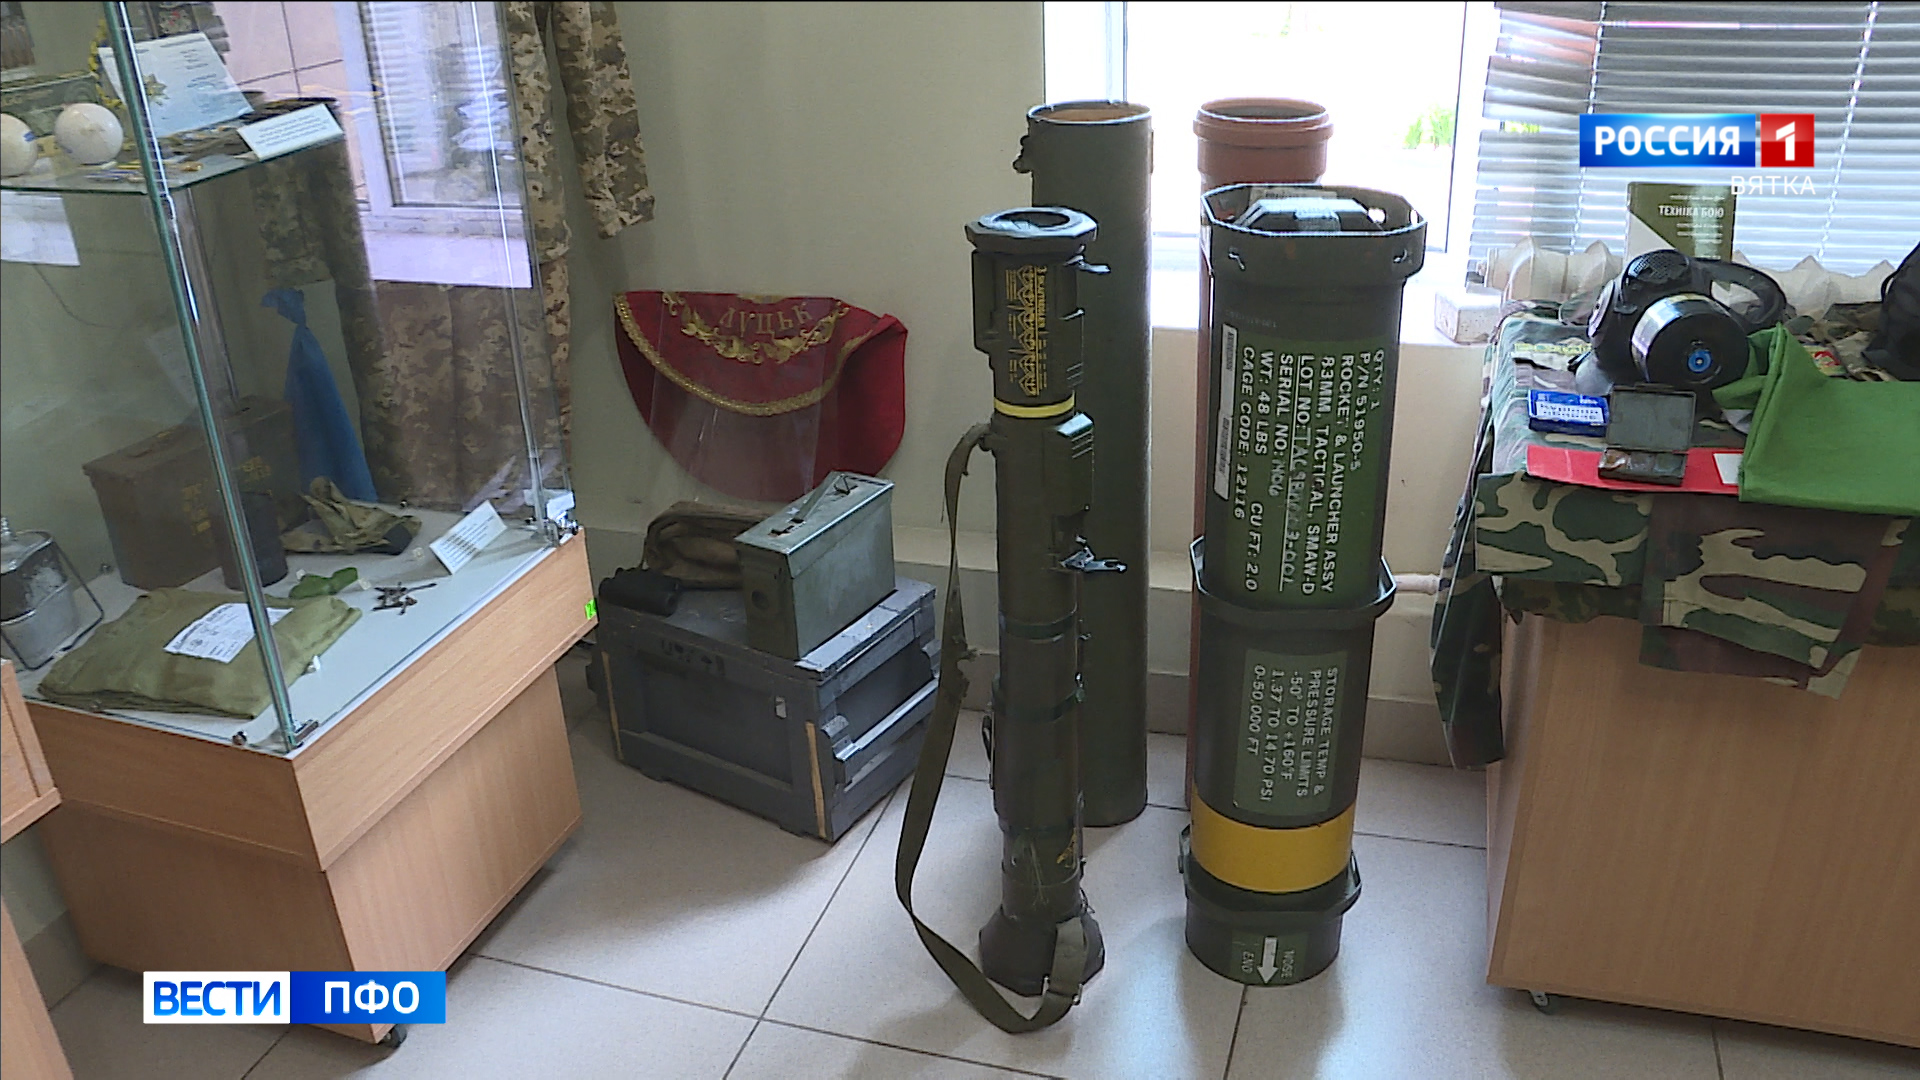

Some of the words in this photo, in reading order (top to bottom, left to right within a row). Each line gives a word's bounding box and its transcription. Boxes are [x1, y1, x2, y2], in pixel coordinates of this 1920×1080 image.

[1701, 206, 1724, 218] БОЮ
[1242, 347, 1254, 395] CAGE
[1260, 352, 1273, 384] WT:
[1276, 354, 1293, 416] SERIAL
[1299, 355, 1314, 391] LOT
[1357, 352, 1370, 388] P/N
[1372, 349, 1384, 392] QTY:
[1258, 391, 1271, 414] 48
[1337, 355, 1354, 428] ROCKET
[1371, 400, 1380, 409] 1
[1238, 402, 1251, 456] CODE:
[1255, 421, 1269, 454] LBS
[1274, 424, 1288, 456] NO:
[1335, 435, 1347, 447] &
[1351, 395, 1366, 471] 51950-5
[1307, 426, 1329, 517] TACTICAL,
[1234, 463, 1248, 519] 12116
[1325, 453, 1345, 543] LAUNCHER
[1250, 503, 1262, 526] CU
[1248, 532, 1260, 557] FT:
[1303, 525, 1320, 594] SMAW-D
[1246, 562, 1258, 591] 2.0
[1321, 550, 1336, 592] ASSY
[1271, 670, 1284, 703] 1.37
[1321, 667, 1338, 736] STORAGE
[1268, 709, 1281, 728] TO
[1287, 706, 1300, 726] TO
[1302, 669, 1321, 746] PRESSURE
[1247, 737, 1259, 756] FT
[1263, 734, 1278, 774] 14.70
[1316, 740, 1329, 779] TEMP
[1260, 779, 1273, 801] PSI
[1297, 751, 1312, 797] LIMITS
[1314, 785, 1325, 795] &
[1242, 951, 1254, 973] END
[1281, 950, 1295, 978] NOSE
